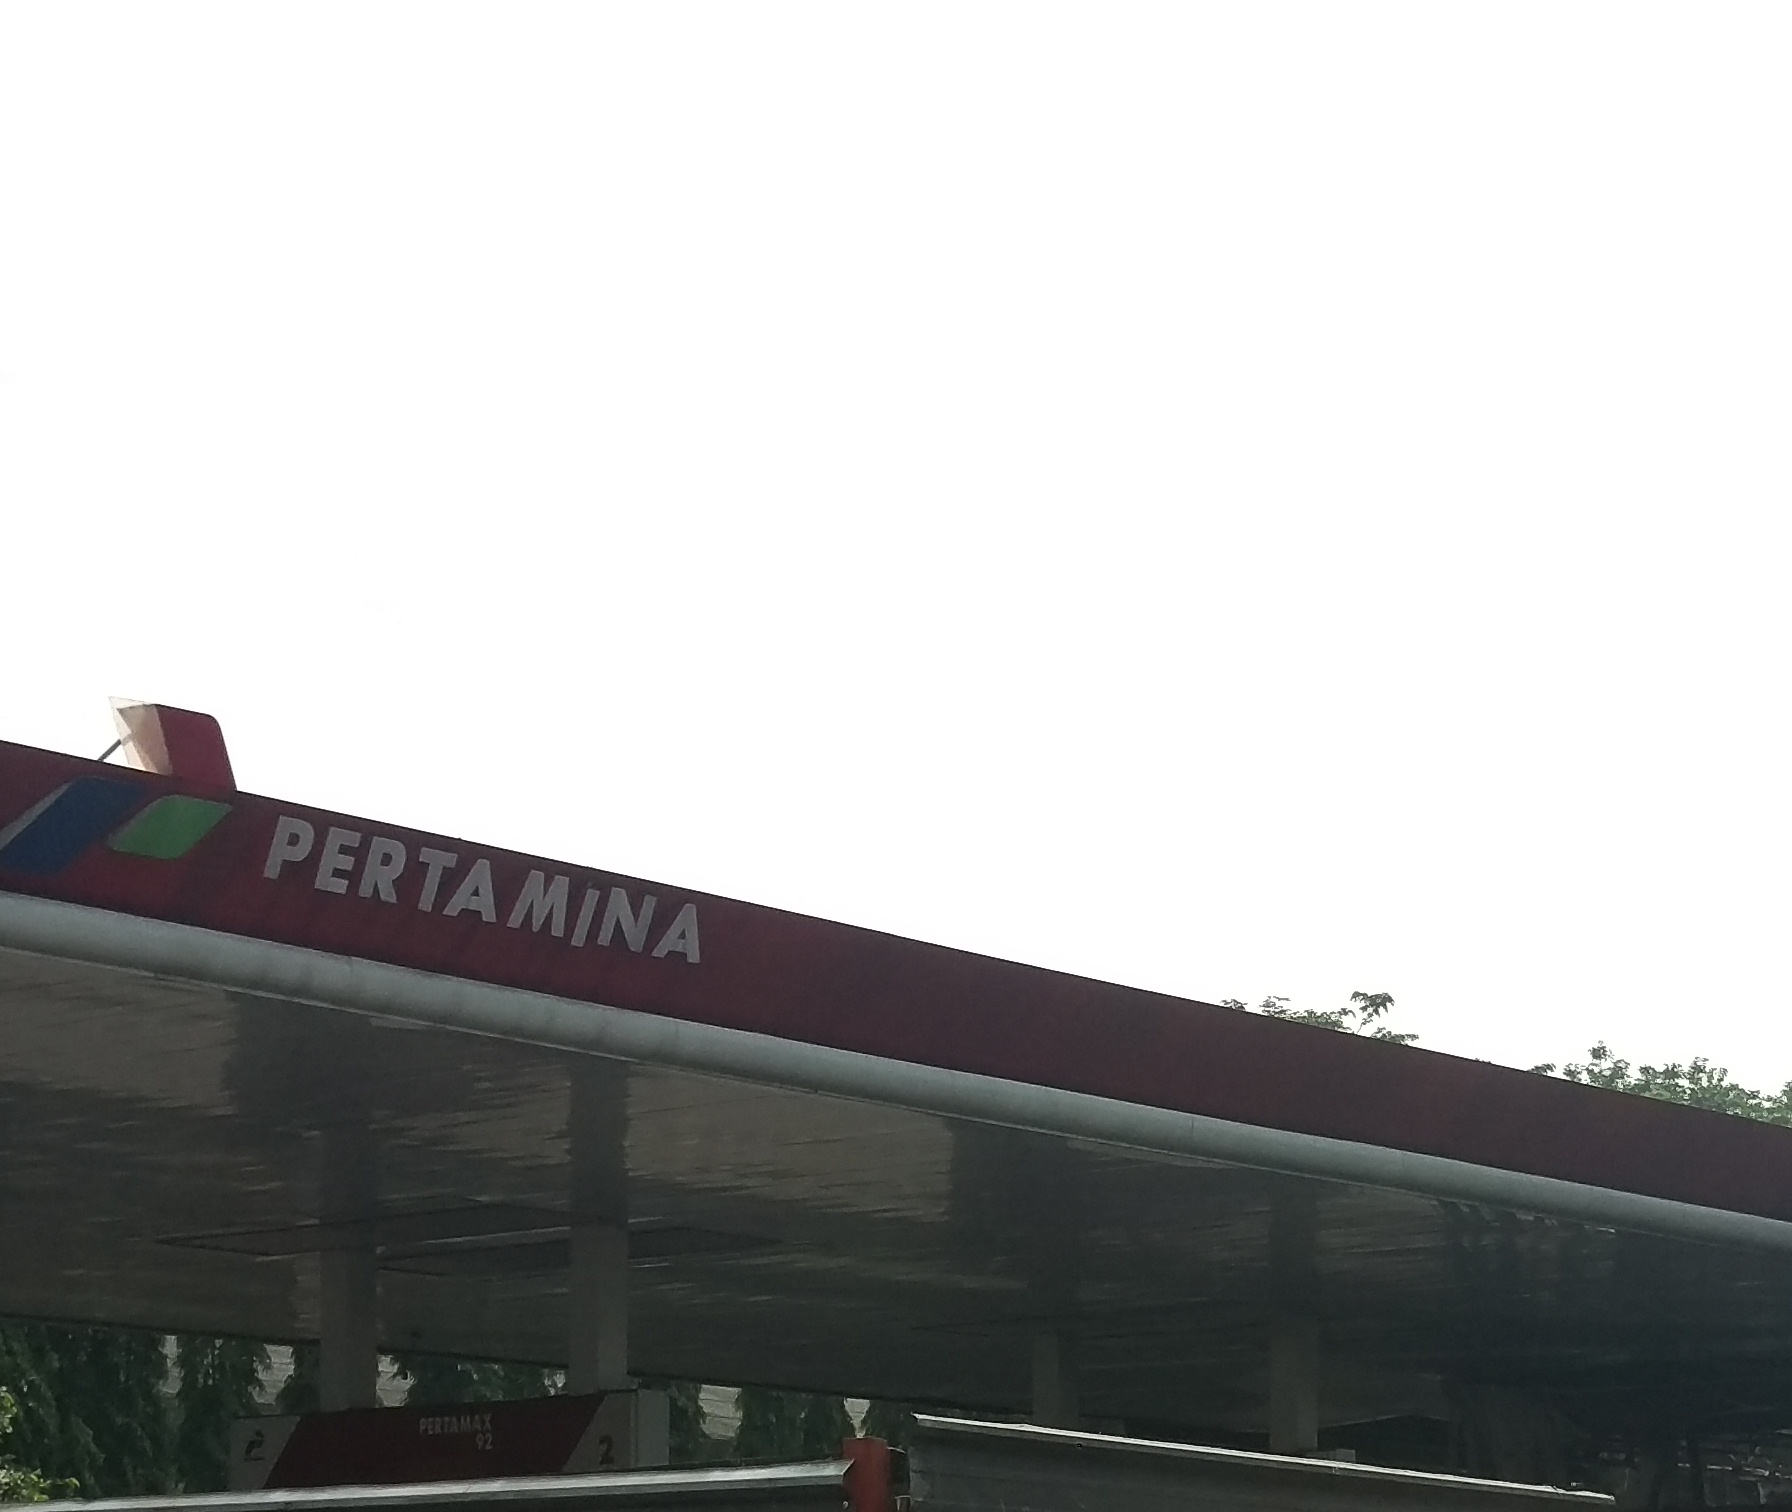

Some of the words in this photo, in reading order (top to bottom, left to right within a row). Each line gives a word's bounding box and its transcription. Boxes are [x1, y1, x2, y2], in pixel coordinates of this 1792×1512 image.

[263, 815, 701, 963] PERTAMINA
[419, 1413, 492, 1435] PERTAMAX
[475, 1432, 493, 1450] 92
[598, 1435, 614, 1465] 2
